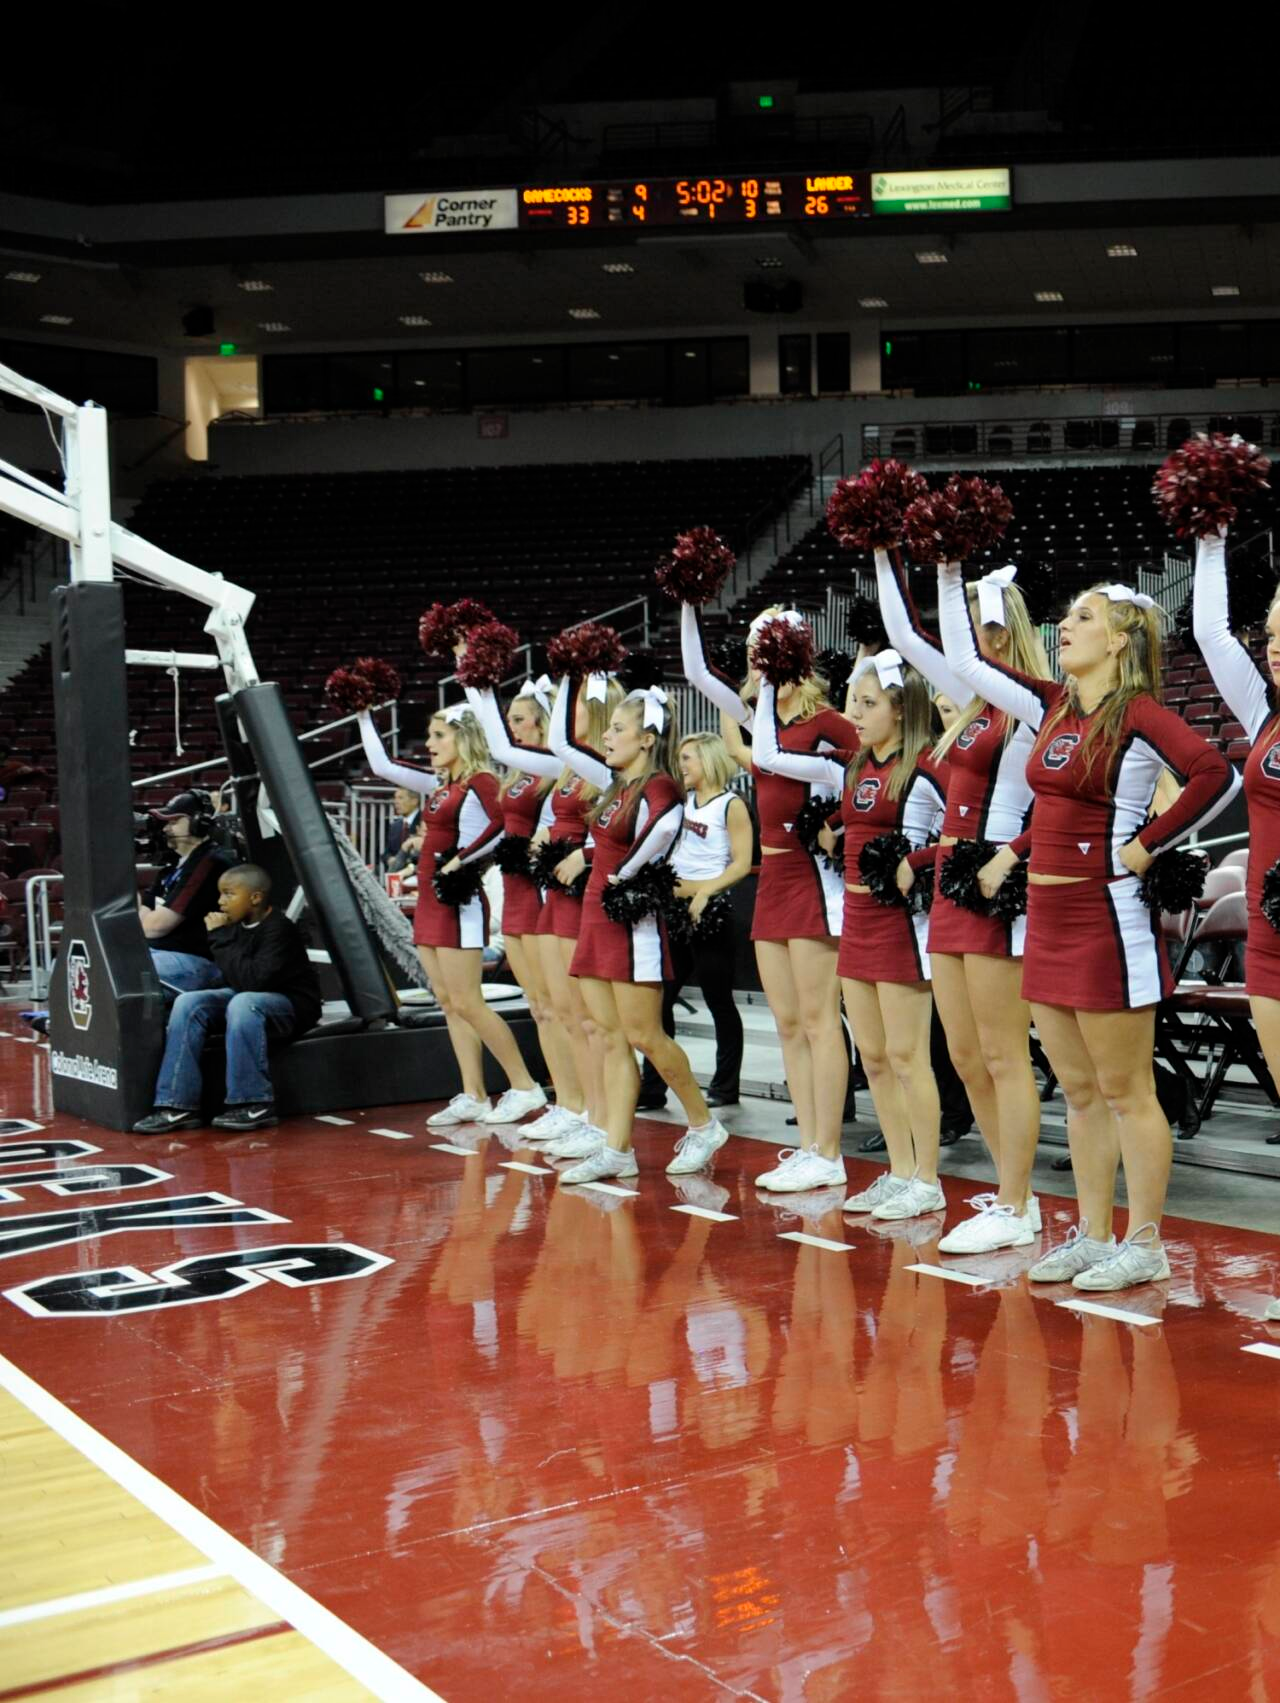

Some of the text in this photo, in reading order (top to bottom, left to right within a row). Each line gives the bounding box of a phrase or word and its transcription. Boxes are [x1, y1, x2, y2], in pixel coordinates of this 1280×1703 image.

[676, 179, 725, 204] 5:02
[741, 179, 758, 198] 10
[806, 176, 853, 191] LANDER
[937, 181, 974, 192] Medical
[976, 179, 1007, 190] Center
[635, 184, 648, 202] 9
[437, 197, 497, 211] Corner
[708, 202, 715, 219] 1
[745, 198, 757, 218] 3
[804, 195, 829, 215] 26
[435, 212, 493, 228] Pantry
[568, 206, 590, 224] 33
[631, 205, 646, 221] 4
